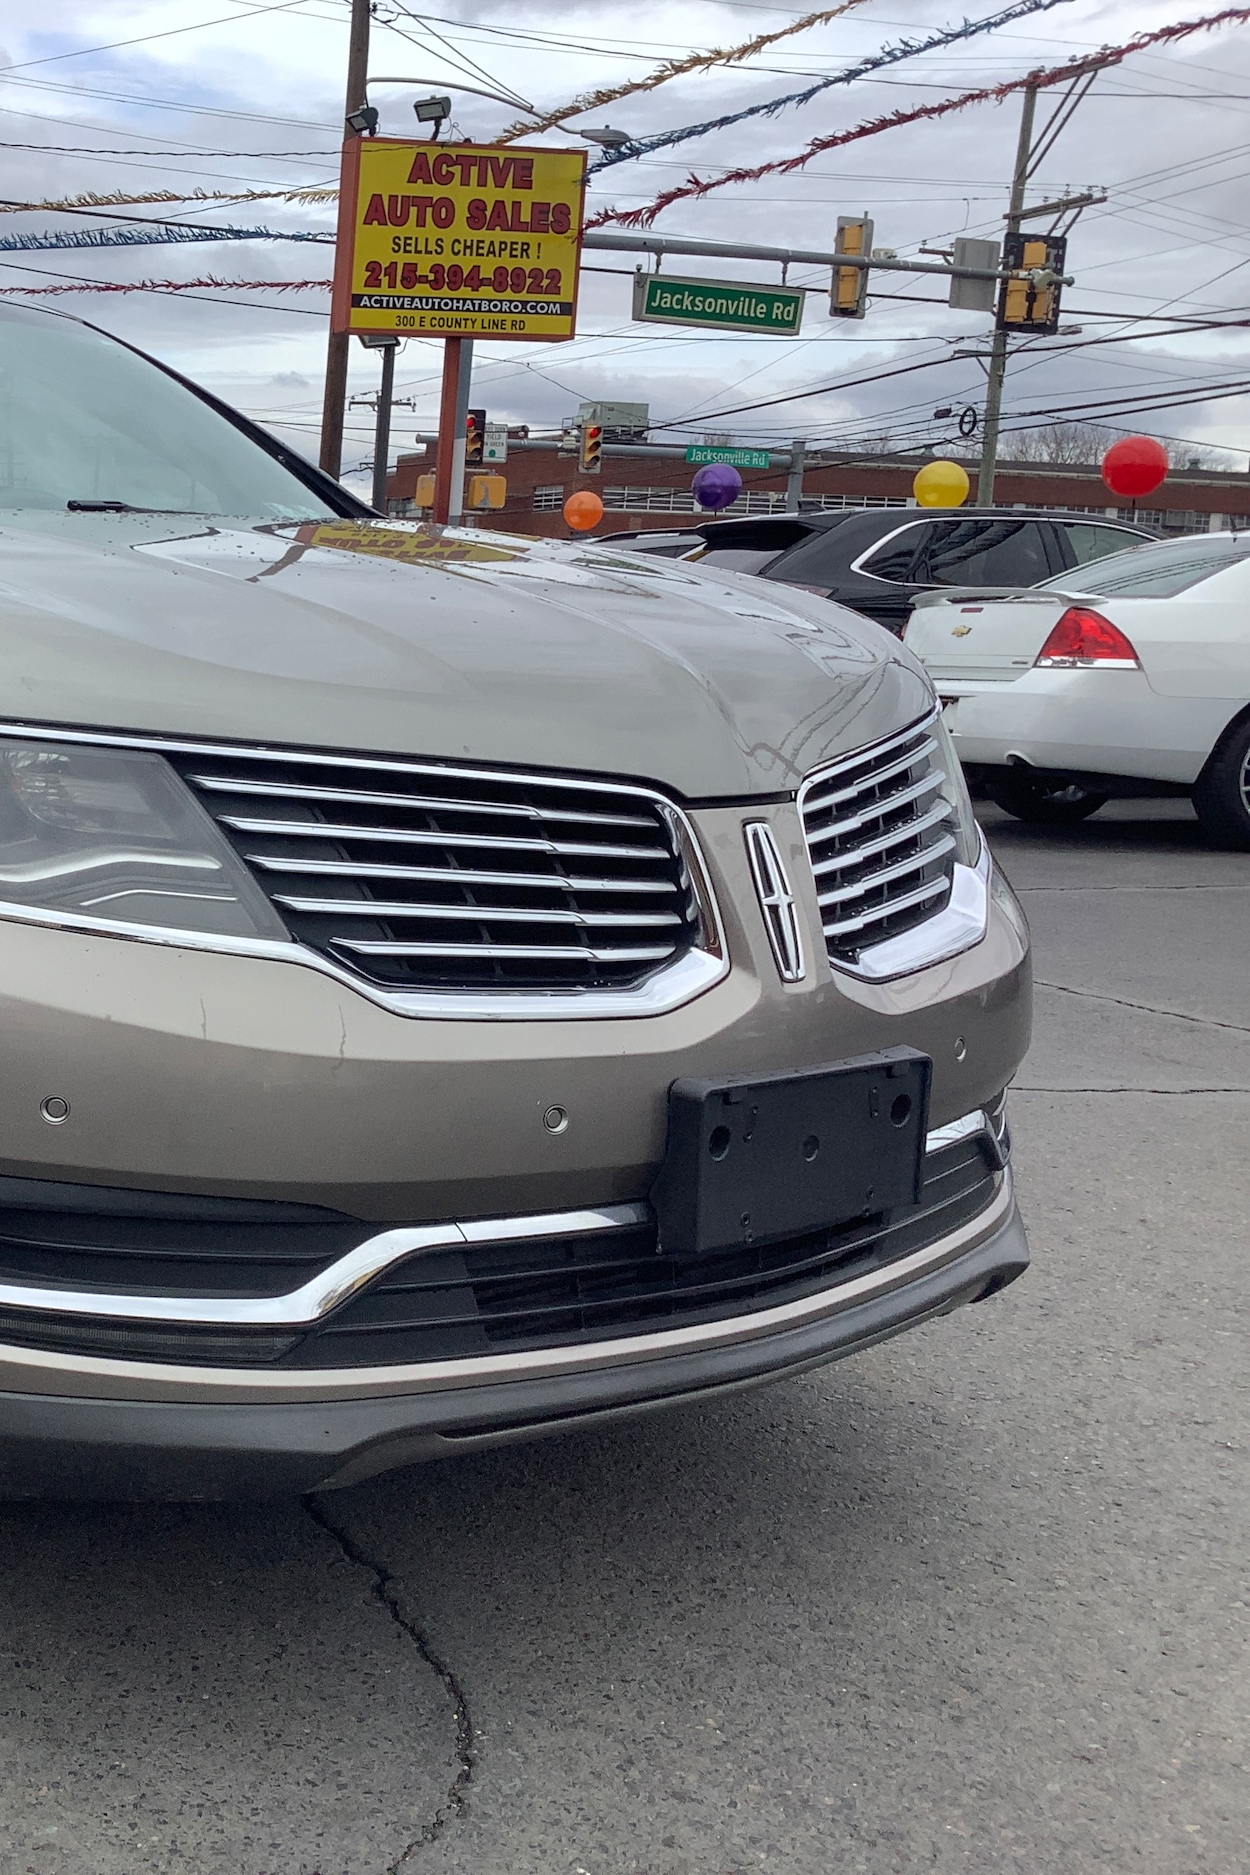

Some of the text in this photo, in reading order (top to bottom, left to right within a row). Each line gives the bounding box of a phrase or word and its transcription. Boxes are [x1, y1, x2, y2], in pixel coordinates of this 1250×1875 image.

[406, 152, 534, 190] ACTIVE
[363, 193, 572, 234] AUTO SALES
[391, 235, 444, 256] SELLS
[451, 238, 530, 259] CHEAPER
[363, 260, 562, 295] 215-394-8922
[359, 295, 561, 314] ACTIVEAUTOHATBORO.COM
[651, 289, 795, 321] Jacksonville Rd
[395, 315, 526, 331] 300 E COUNTY LINE RD
[691, 449, 765, 466] Jacksonville Rd
